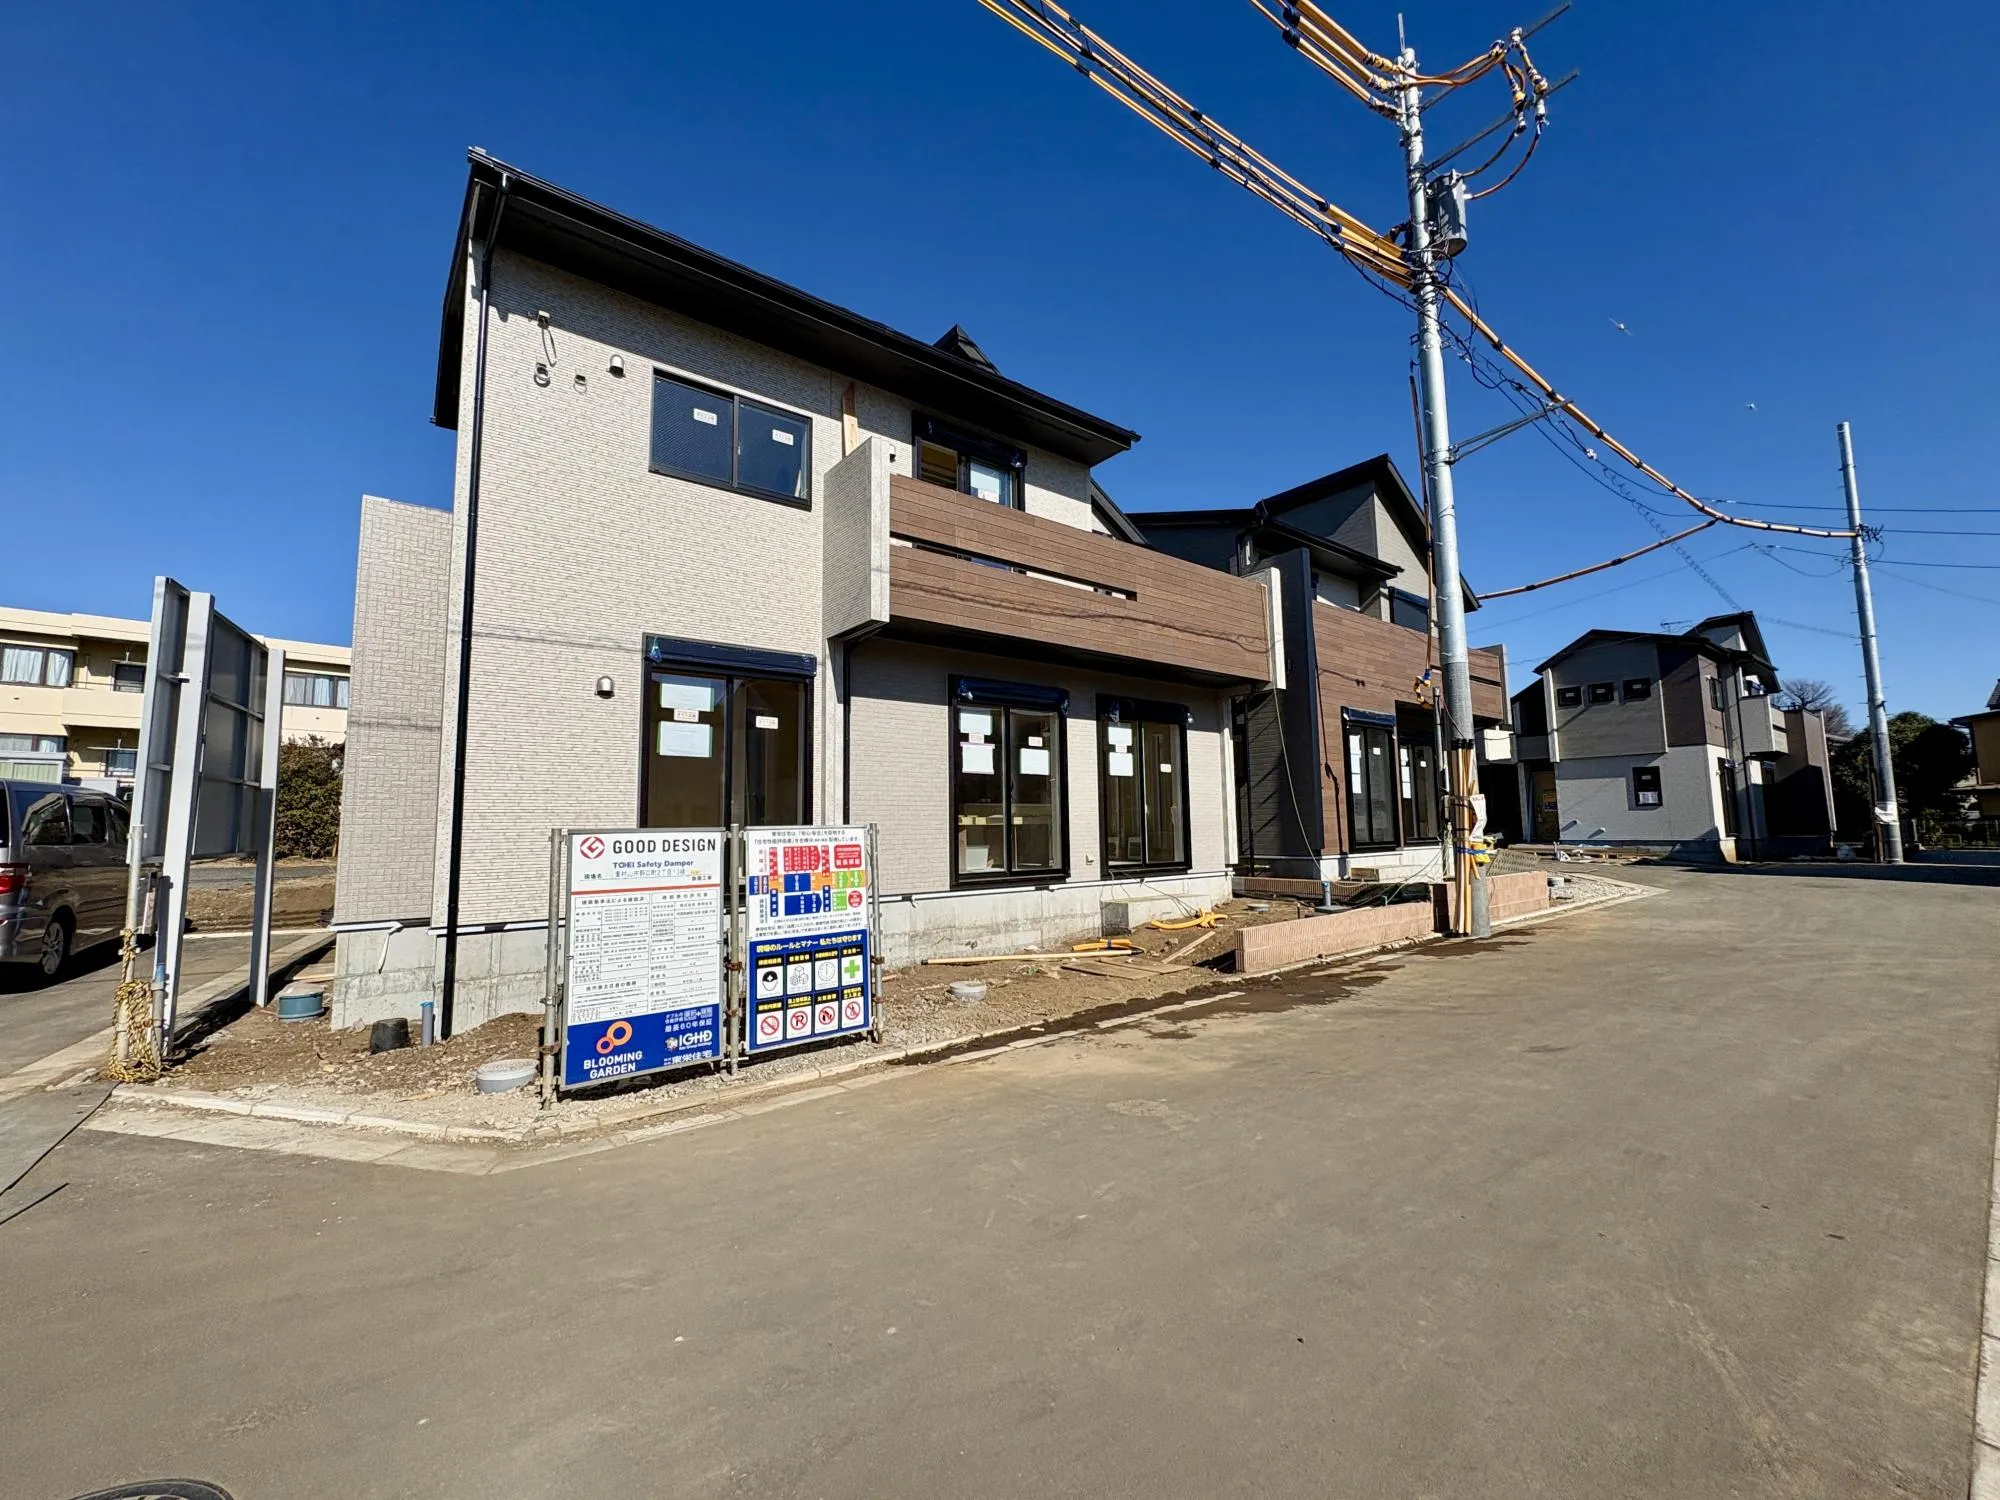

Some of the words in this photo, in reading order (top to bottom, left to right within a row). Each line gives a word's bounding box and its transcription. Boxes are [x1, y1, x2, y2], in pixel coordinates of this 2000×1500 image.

[613, 840, 656, 854] GOOD
[663, 838, 716, 852] DESIGN
[637, 860, 662, 869] Safety
[664, 860, 694, 869] Damper
[584, 1051, 643, 1070] BLOOMING
[590, 1063, 636, 1079] GARDEN
